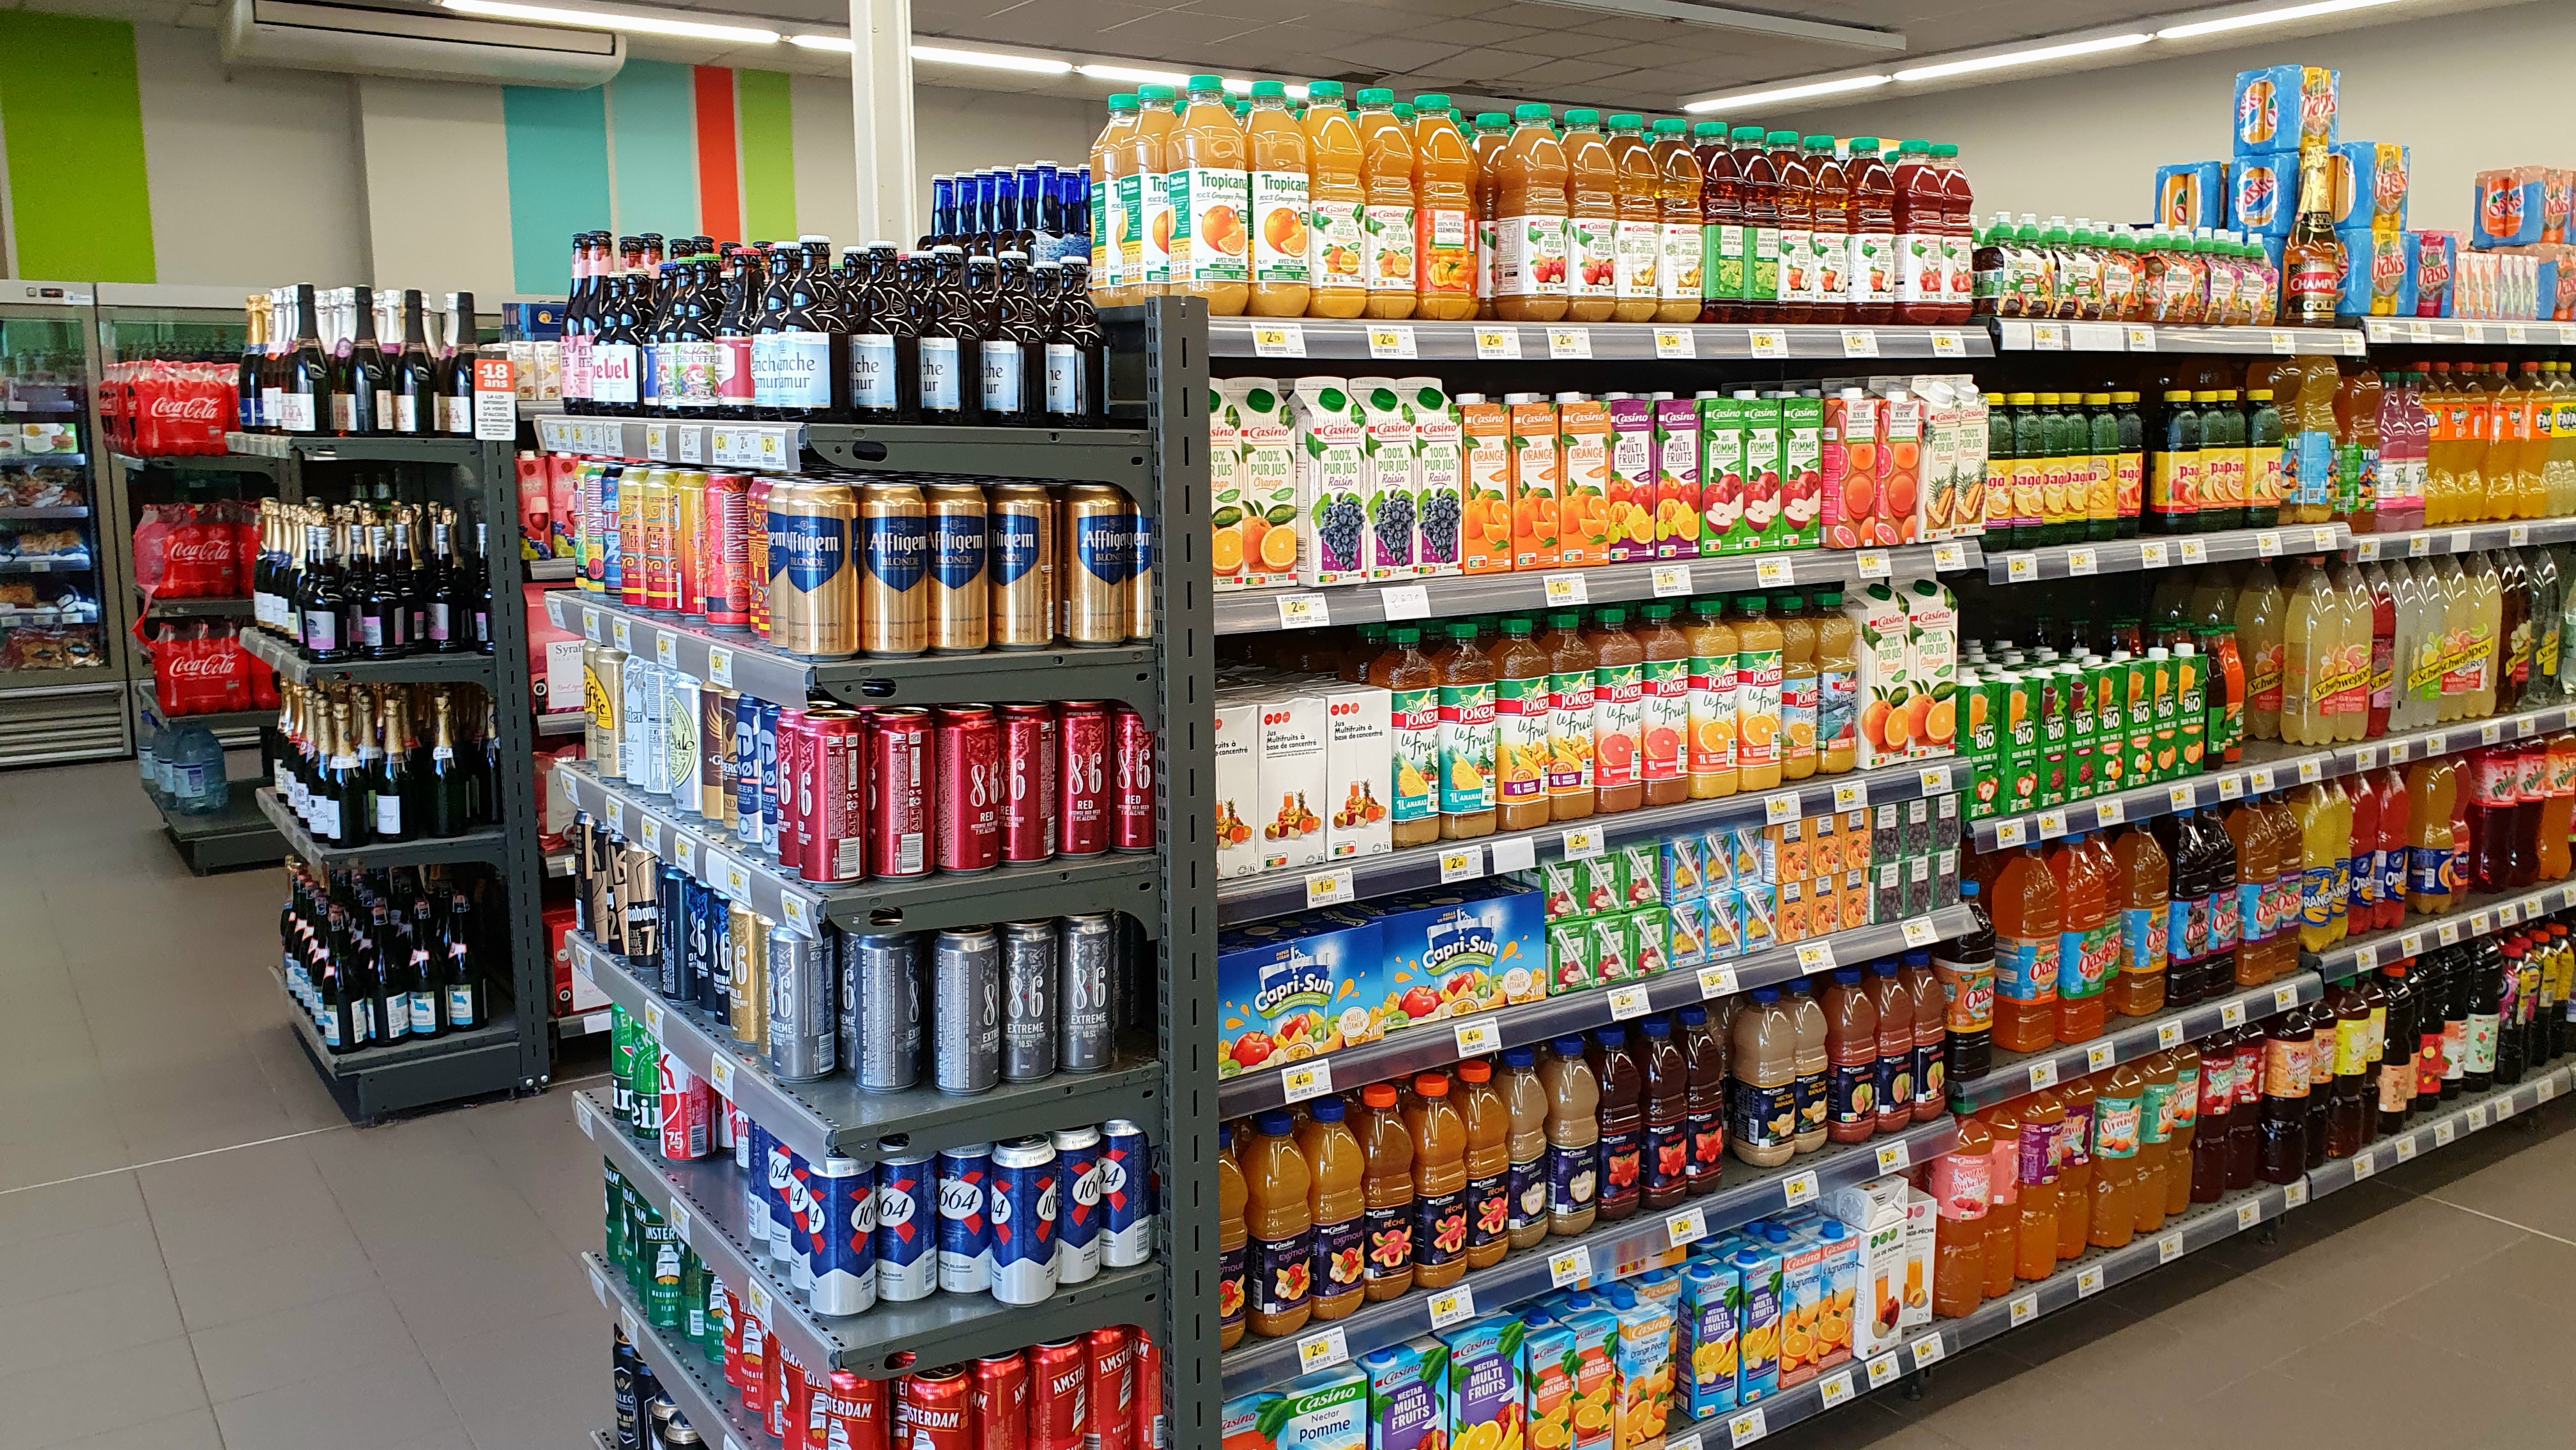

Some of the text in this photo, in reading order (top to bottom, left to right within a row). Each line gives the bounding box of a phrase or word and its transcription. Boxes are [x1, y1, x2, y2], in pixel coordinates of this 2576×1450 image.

[1378, 210, 1404, 219] Casino
[2372, 255, 2405, 281] Oasis
[2417, 265, 2449, 287] Oasis
[2290, 277, 2336, 290] CHAMPO
[2303, 300, 2335, 311] GOLD
[479, 363, 508, 378] -18
[151, 397, 218, 419] Coca-Cola
[1712, 409, 1740, 419] Casino
[1749, 408, 1777, 418] Casino
[1790, 409, 1819, 418] Casino
[1472, 413, 1505, 426] Casino
[1521, 413, 1553, 425] Casino
[1570, 412, 1605, 425] Casino
[1616, 413, 1648, 424] Casino
[1665, 412, 1695, 422] Casino
[1250, 427, 1287, 439] Casino
[1323, 424, 1360, 438] Casino
[1377, 423, 1411, 435] Casino
[1423, 422, 1456, 435] Casino
[1383, 447, 1404, 458] 100%
[1429, 447, 1450, 458] 100%
[1571, 447, 1603, 459] ORANGE
[1620, 443, 1642, 453] MULTI
[1668, 442, 1689, 451] MULTI
[1712, 443, 1738, 453] POMME
[1751, 442, 1774, 452] POMME
[1791, 442, 1816, 451] POMME
[1257, 450, 1280, 462] 100%
[1329, 450, 1351, 461] 100%
[1473, 450, 1504, 462] ORANGE
[1523, 449, 1552, 461] ORANGE
[1618, 454, 1645, 464] FRUITS
[1666, 452, 1692, 462] FRUITS
[1251, 463, 1286, 477] PUR JUS
[1324, 463, 1357, 475] PUR JUS
[1378, 460, 1409, 472] PUR JUS
[1425, 459, 1455, 472] PUR JUS
[1328, 477, 1354, 486] Raisin
[1382, 474, 1406, 483] Raisin
[1429, 472, 1452, 482] Raisin
[1254, 477, 1283, 491] Orange
[724, 493, 748, 562] DESPERADOS
[868, 531, 926, 555] Affligem
[927, 531, 982, 553] Affligem
[171, 540, 231, 560] Coca-Cola
[790, 557, 825, 566] BLONDE
[882, 557, 919, 566] BLONDE
[1878, 614, 1904, 628] Casino
[1919, 610, 1950, 625] Casino
[1882, 635, 1897, 648] 100%
[1924, 631, 1942, 644] 100%
[555, 644, 583, 656] Syrah
[1878, 648, 1902, 661] PUR JUS
[1919, 642, 1947, 655] PUR JUS
[169, 653, 238, 677] Coca-Cola
[1611, 685, 1641, 702] JOKER
[1656, 679, 1688, 697] JOKER
[1560, 691, 1594, 709] JOKER
[1459, 706, 1495, 723] JOKER
[1616, 705, 1641, 731] fruit
[1661, 700, 1687, 725] fruit
[1404, 711, 1438, 729] JOKER
[1567, 713, 1593, 738] fruit
[1267, 735, 1298, 743] Multifruits
[1356, 730, 1383, 738] concentré
[1455, 725, 1495, 754] le fruit
[1289, 739, 1317, 748] concentré
[1401, 732, 1438, 760] le fruit
[1551, 775, 1560, 785] 1L
[1125, 795, 1140, 804] RED
[1450, 792, 1481, 803] 1L ANANAS
[1000, 806, 1015, 815] RED
[1078, 800, 1093, 809] RED
[1397, 799, 1427, 810] 1L ANANAS
[980, 812, 993, 822] RED
[1422, 936, 1498, 968] Capri-Sun
[1507, 980, 1526, 989] VITAMIN
[1531, 986, 1544, 996] x10
[1254, 973, 1334, 1011] Capri-Sun
[1071, 1012, 1106, 1024] EXTREME
[1346, 1012, 1361, 1021] MULTI
[1008, 1022, 1044, 1033] EXTREME
[1344, 1022, 1364, 1031] VITAMIN
[1368, 1023, 1381, 1036] x10
[1487, 1186, 1505, 1196] PÊCHE
[1445, 1203, 1463, 1214] PÊCHE
[1383, 1218, 1406, 1228] PÊCHE
[1333, 1230, 1363, 1246] EXOTIQUE
[1786, 1251, 1821, 1269] Casino
[1828, 1260, 1855, 1276] Agrumes
[1791, 1274, 1820, 1290] Agrumes
[1752, 1298, 1772, 1310] MULTI
[1705, 1313, 1728, 1325] MULTI
[1752, 1306, 1774, 1319] FRUITS
[1631, 1317, 1670, 1339] Casino
[1704, 1321, 1730, 1334] FRUITS
[1460, 1337, 1497, 1356] Casino
[1473, 1359, 1498, 1372] NECTAR
[1580, 1362, 1611, 1379] ORANGE
[1382, 1363, 1421, 1385] Casino
[1471, 1367, 1502, 1387] MULTI
[1544, 1375, 1563, 1386] NECTAR
[1397, 1386, 1423, 1401] NECTAR
[1468, 1378, 1505, 1401] FRUITS
[1538, 1380, 1569, 1399] ORANGE
[1296, 1387, 1356, 1414] Casino
[1394, 1394, 1426, 1415] MULTI
[1311, 1410, 1339, 1423] Nectar
[1392, 1406, 1430, 1430] FRUITS
[1300, 1419, 1351, 1443] Pomme
